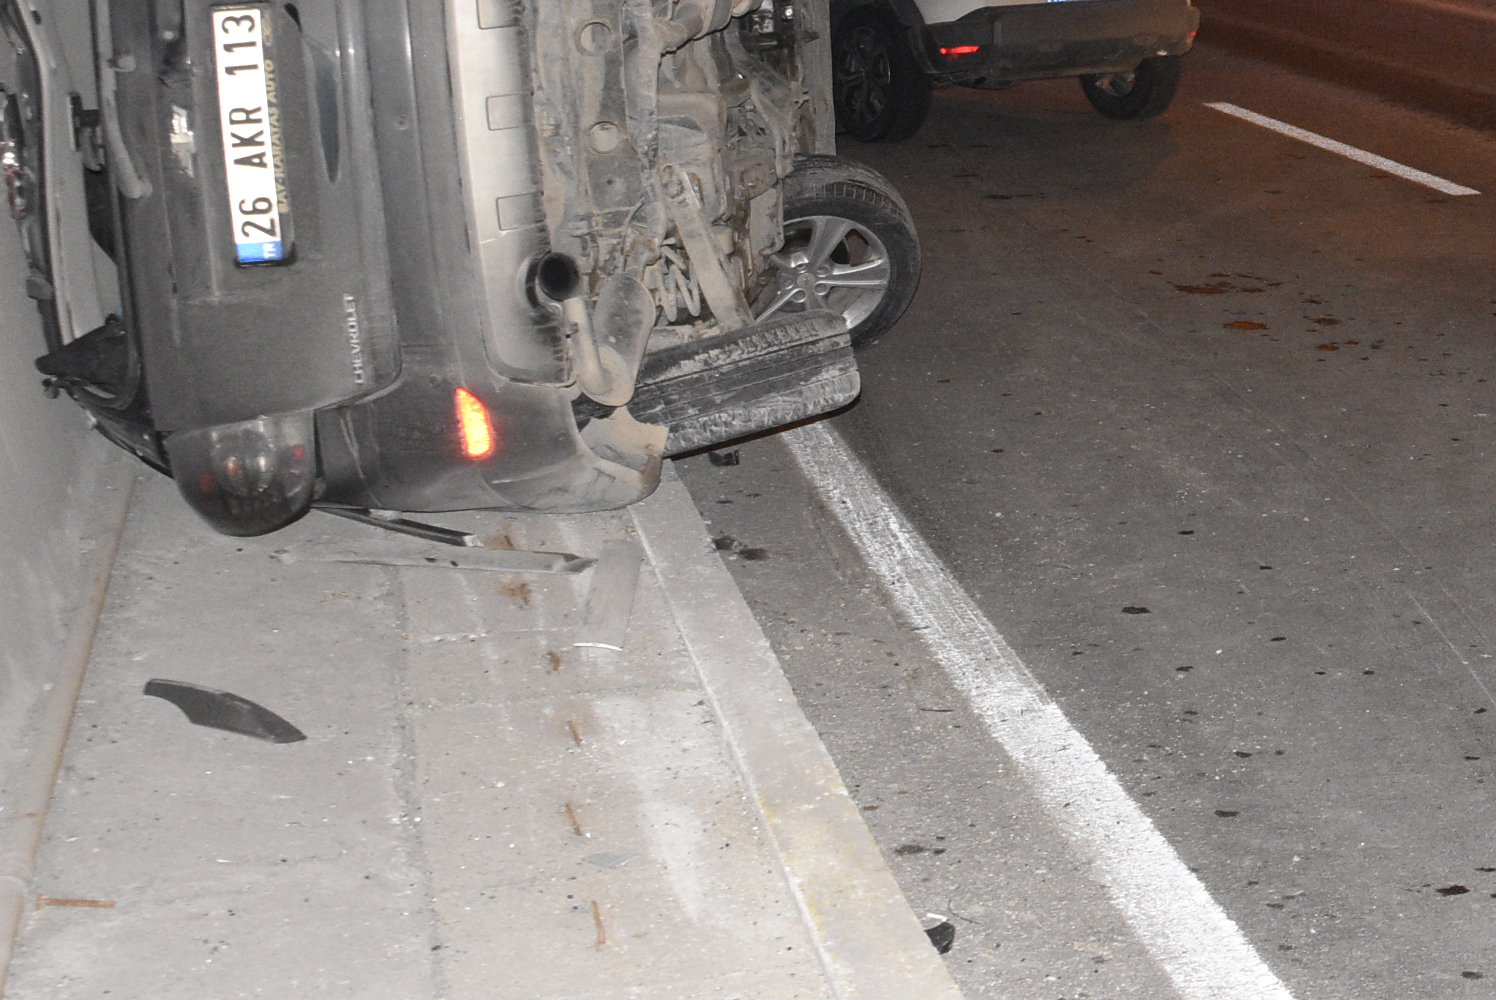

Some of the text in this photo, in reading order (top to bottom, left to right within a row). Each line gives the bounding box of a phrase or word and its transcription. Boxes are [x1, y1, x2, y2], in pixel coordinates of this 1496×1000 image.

[264, 58, 277, 104] AUTO
[221, 14, 276, 239] 26 AKR 113
[263, 242, 276, 259] TR
[343, 293, 364, 384] CHEVROLET
